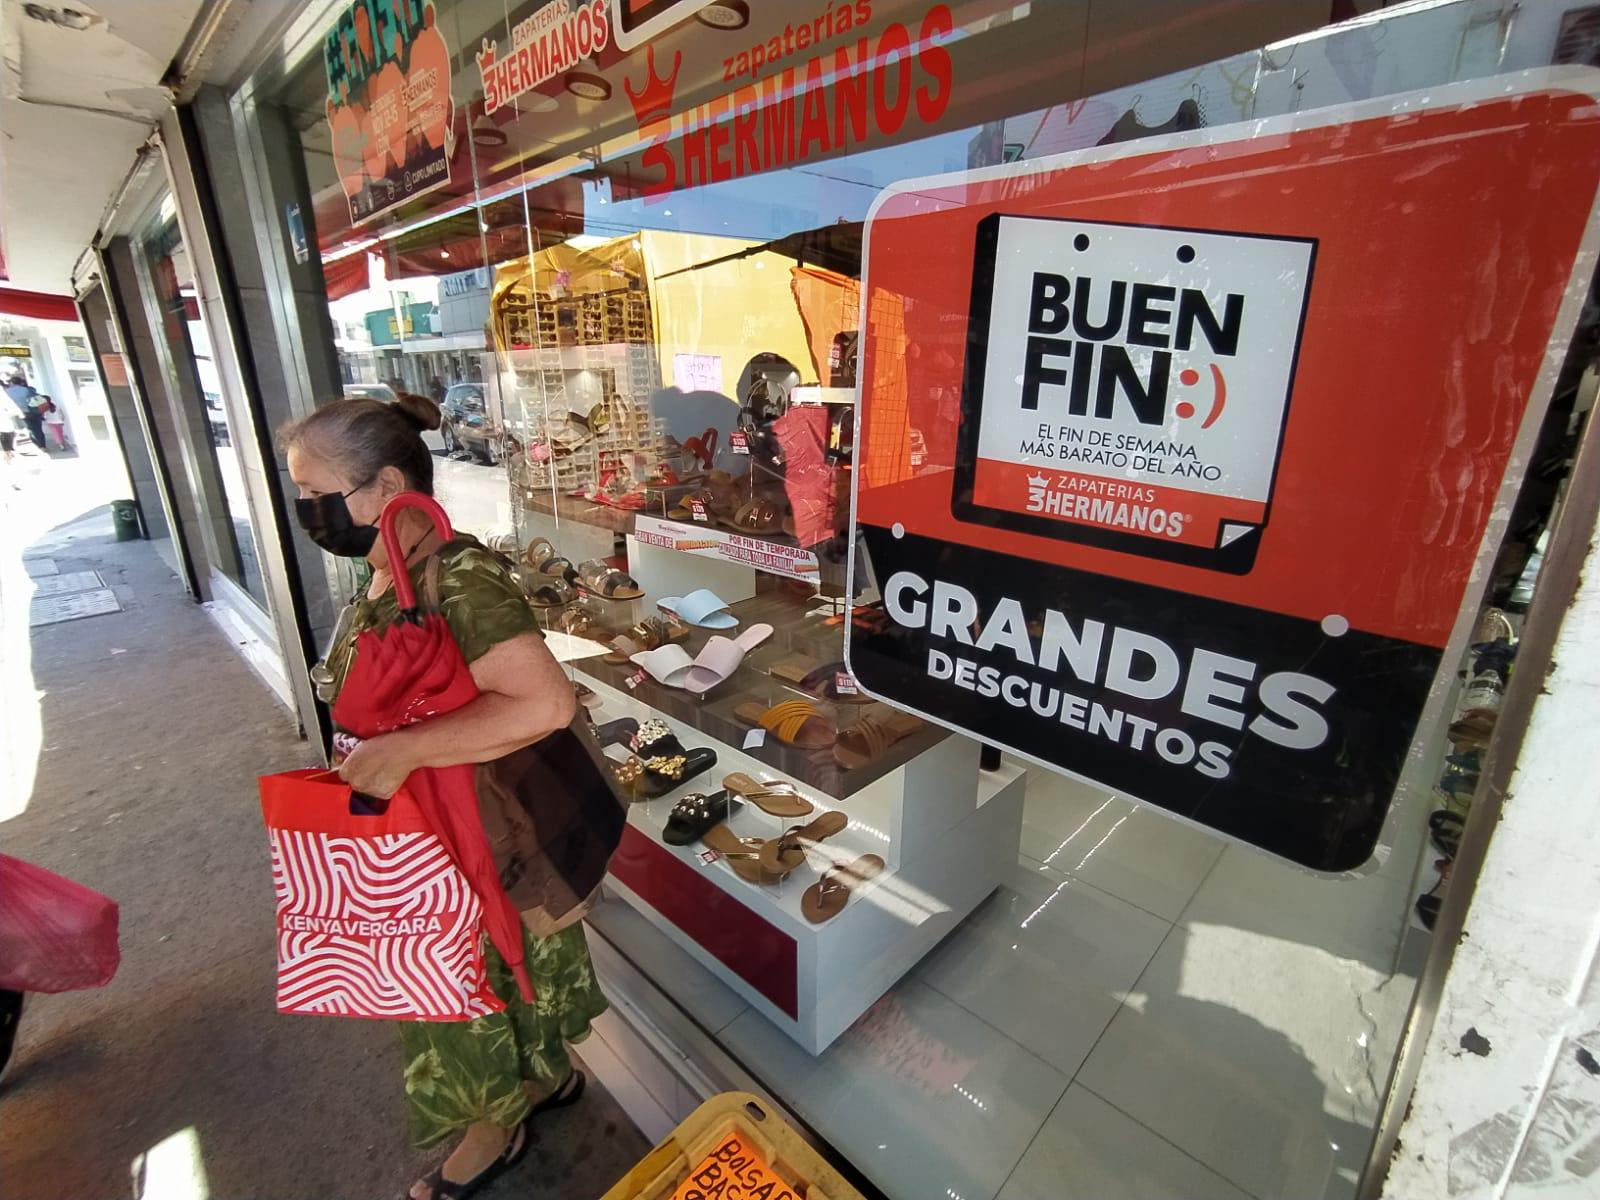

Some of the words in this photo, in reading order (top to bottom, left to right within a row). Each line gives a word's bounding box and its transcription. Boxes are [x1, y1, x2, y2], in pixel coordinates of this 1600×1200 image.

[514, 0, 569, 46] ZAPATERIAS
[722, 0, 872, 82] zapaterías
[1027, 271, 1245, 356] BUEN
[1019, 436, 1054, 458] MÁS
[1059, 445, 1128, 468] BARATO
[1132, 455, 1166, 474] DEL
[1171, 460, 1222, 481] AÑO
[1038, 423, 1054, 440] EL
[1059, 426, 1084, 443] FIN
[1088, 430, 1112, 448] DE
[1115, 434, 1198, 460] SEMANA
[1057, 475, 1155, 503] ZAPATERIAS
[729, 534, 742, 545] POR
[743, 537, 754, 549] FIN
[755, 540, 764, 551] DE
[766, 543, 810, 561] TEMPORADA
[884, 570, 1337, 750] GRANDES
[926, 648, 1234, 779] DESCUENTOS
